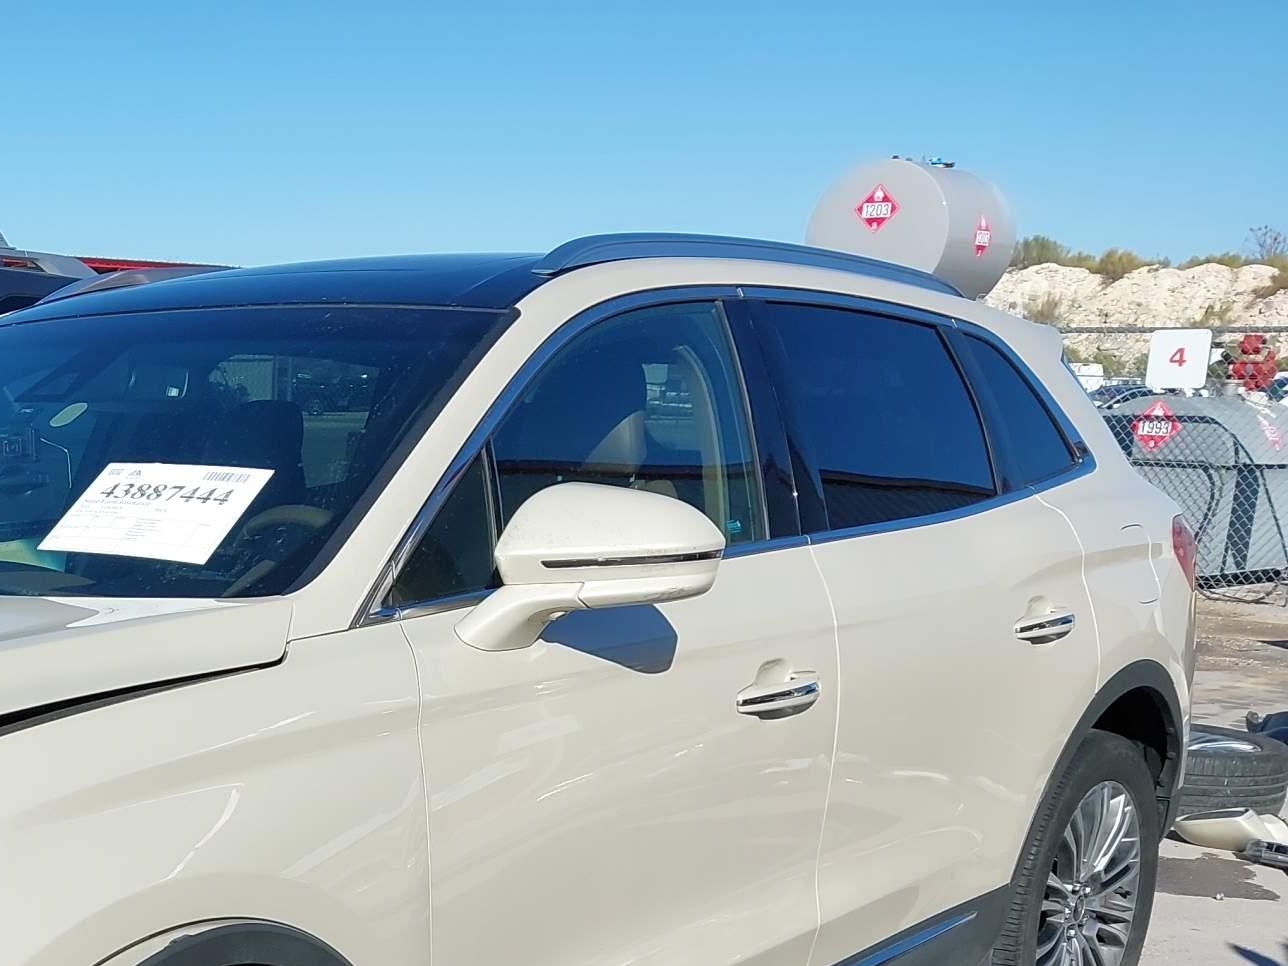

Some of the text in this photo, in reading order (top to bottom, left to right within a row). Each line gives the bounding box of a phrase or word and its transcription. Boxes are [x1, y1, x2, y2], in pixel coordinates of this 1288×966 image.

[865, 203, 889, 217] 1203
[1169, 347, 1187, 367] 4
[1141, 420, 1170, 434] 1993
[100, 482, 235, 506] 43887444
